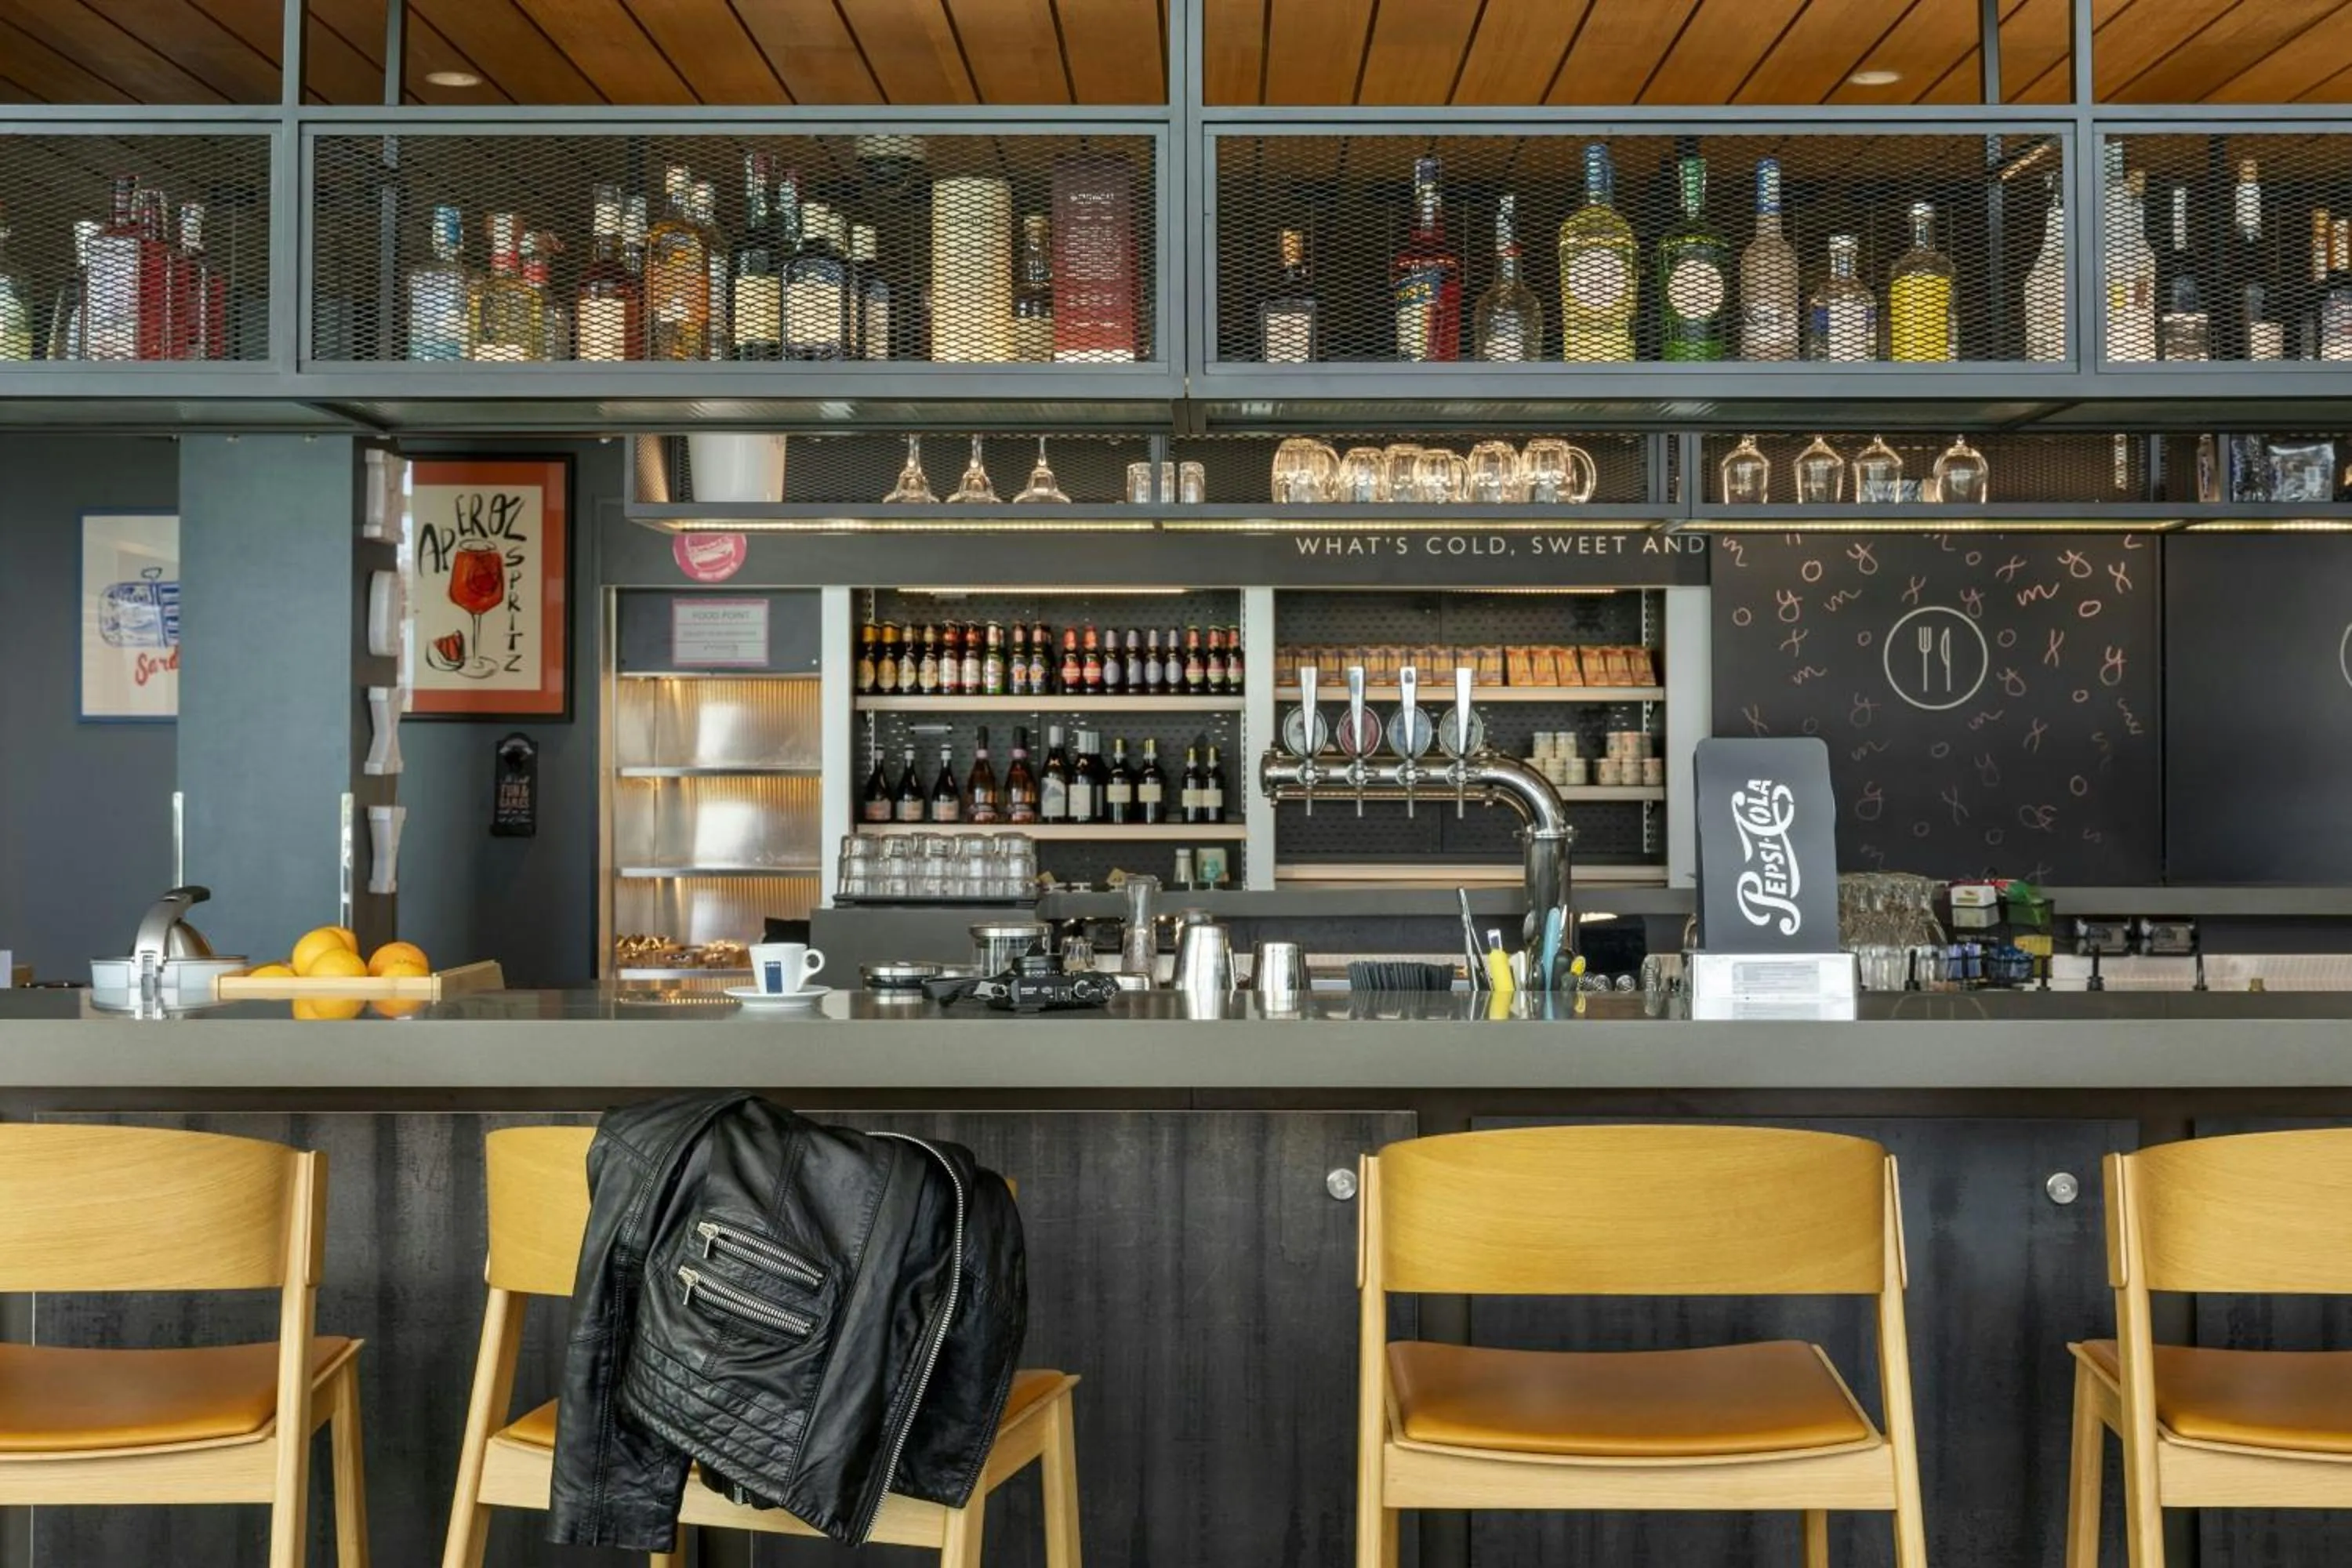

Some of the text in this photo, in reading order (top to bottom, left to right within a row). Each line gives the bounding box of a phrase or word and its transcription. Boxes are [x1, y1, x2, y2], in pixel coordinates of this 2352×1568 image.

[418, 493, 527, 577] APEROL
[1295, 535, 1705, 557] WHAT'S COLD, SWEET AND
[503, 546, 525, 672] SPRITZ
